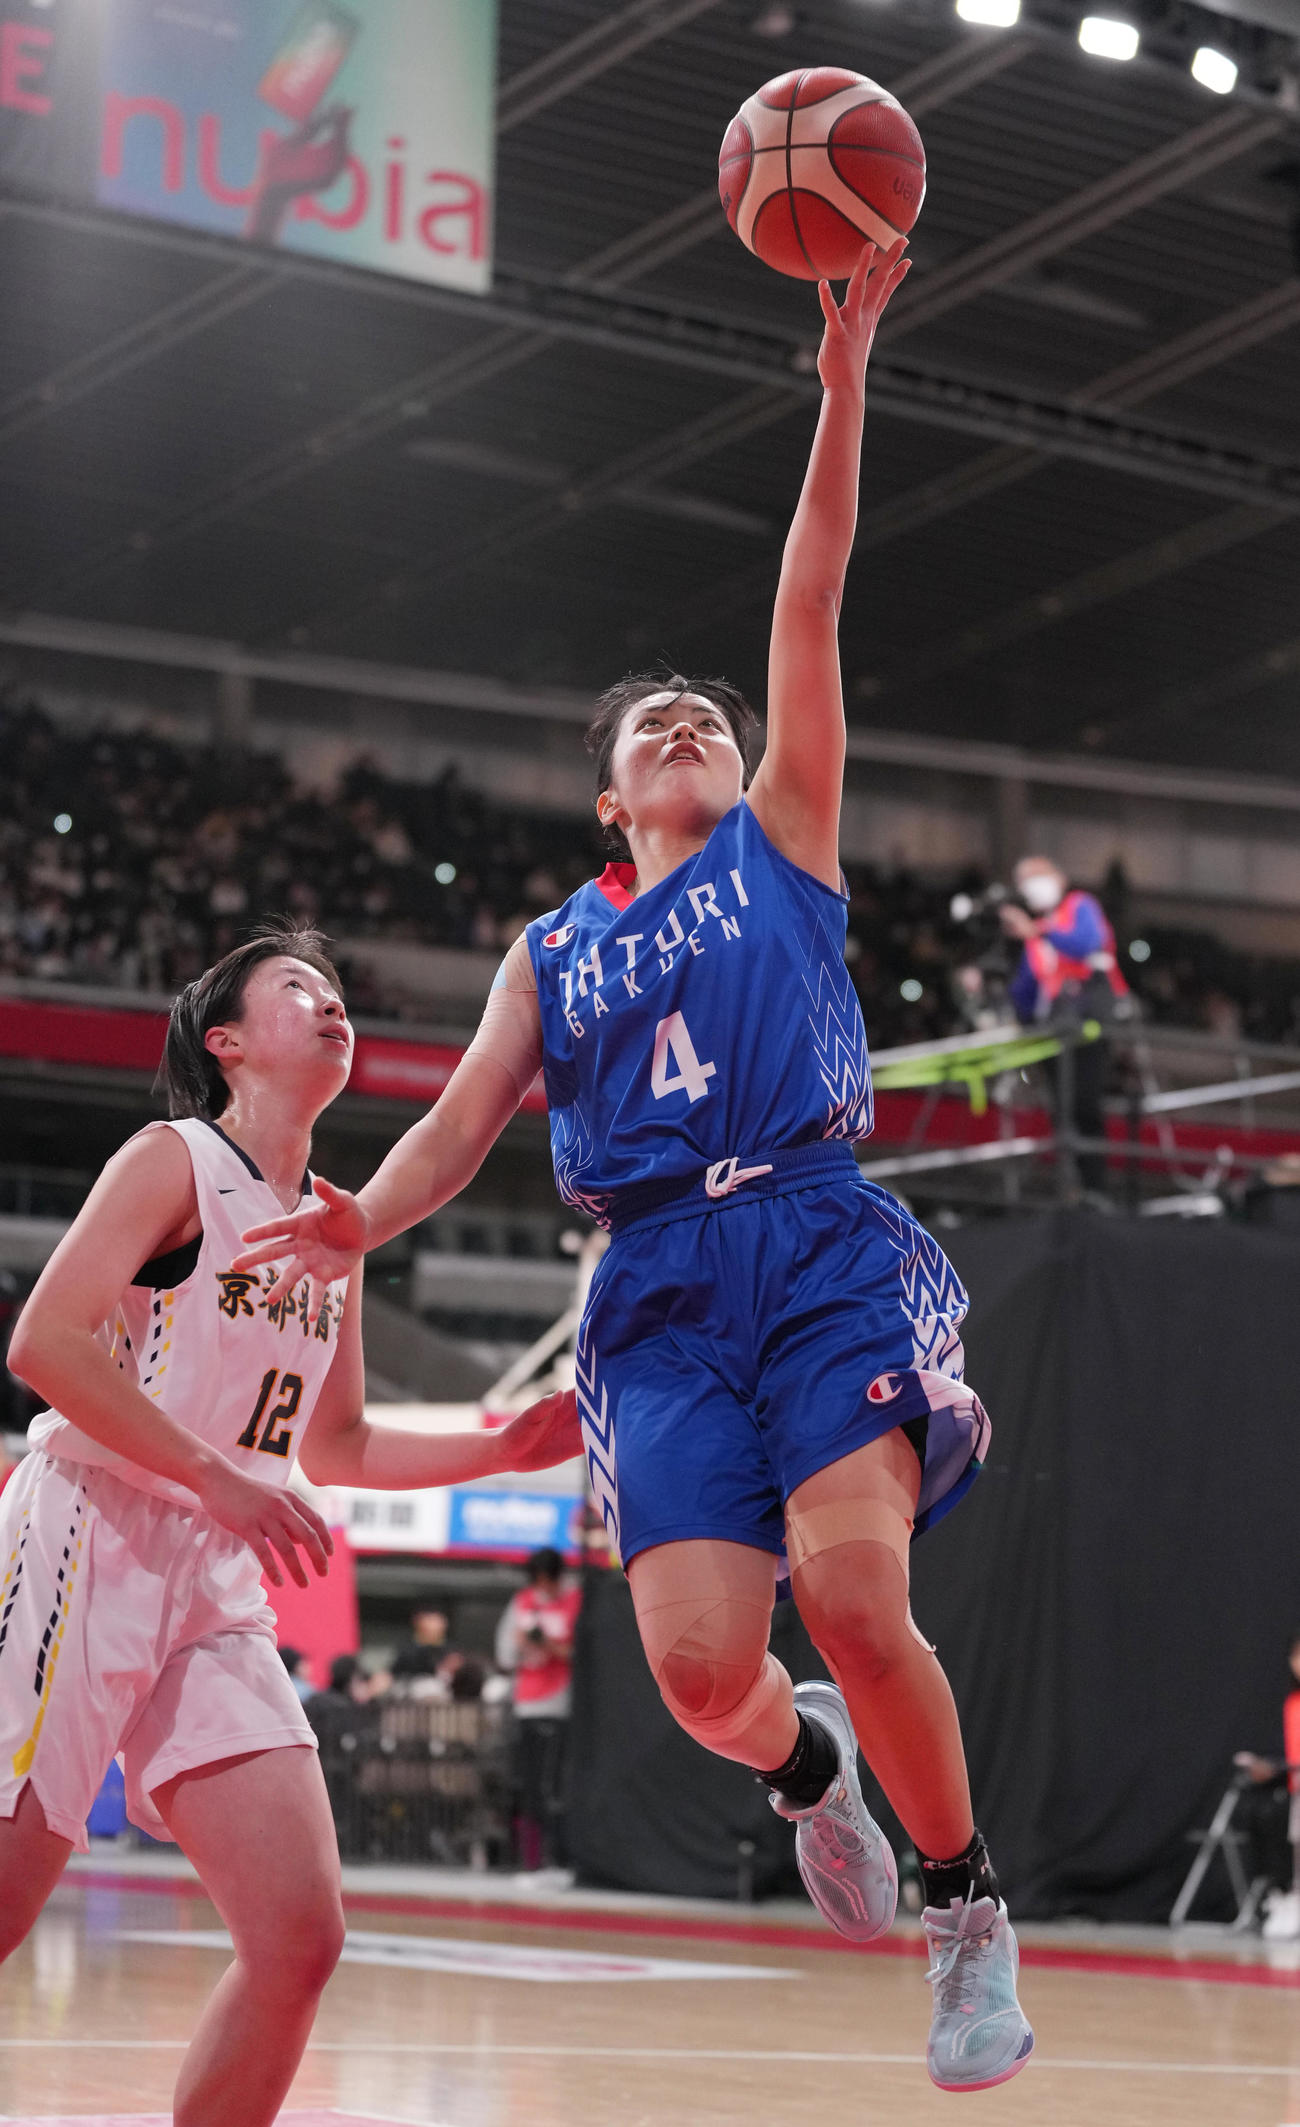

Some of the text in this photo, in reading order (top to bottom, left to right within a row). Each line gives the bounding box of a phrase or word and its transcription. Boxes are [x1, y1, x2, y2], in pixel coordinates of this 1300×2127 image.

[567, 915, 742, 1038] GAKUEN
[650, 1009, 717, 1104] 4
[236, 1367, 304, 1459] 12
